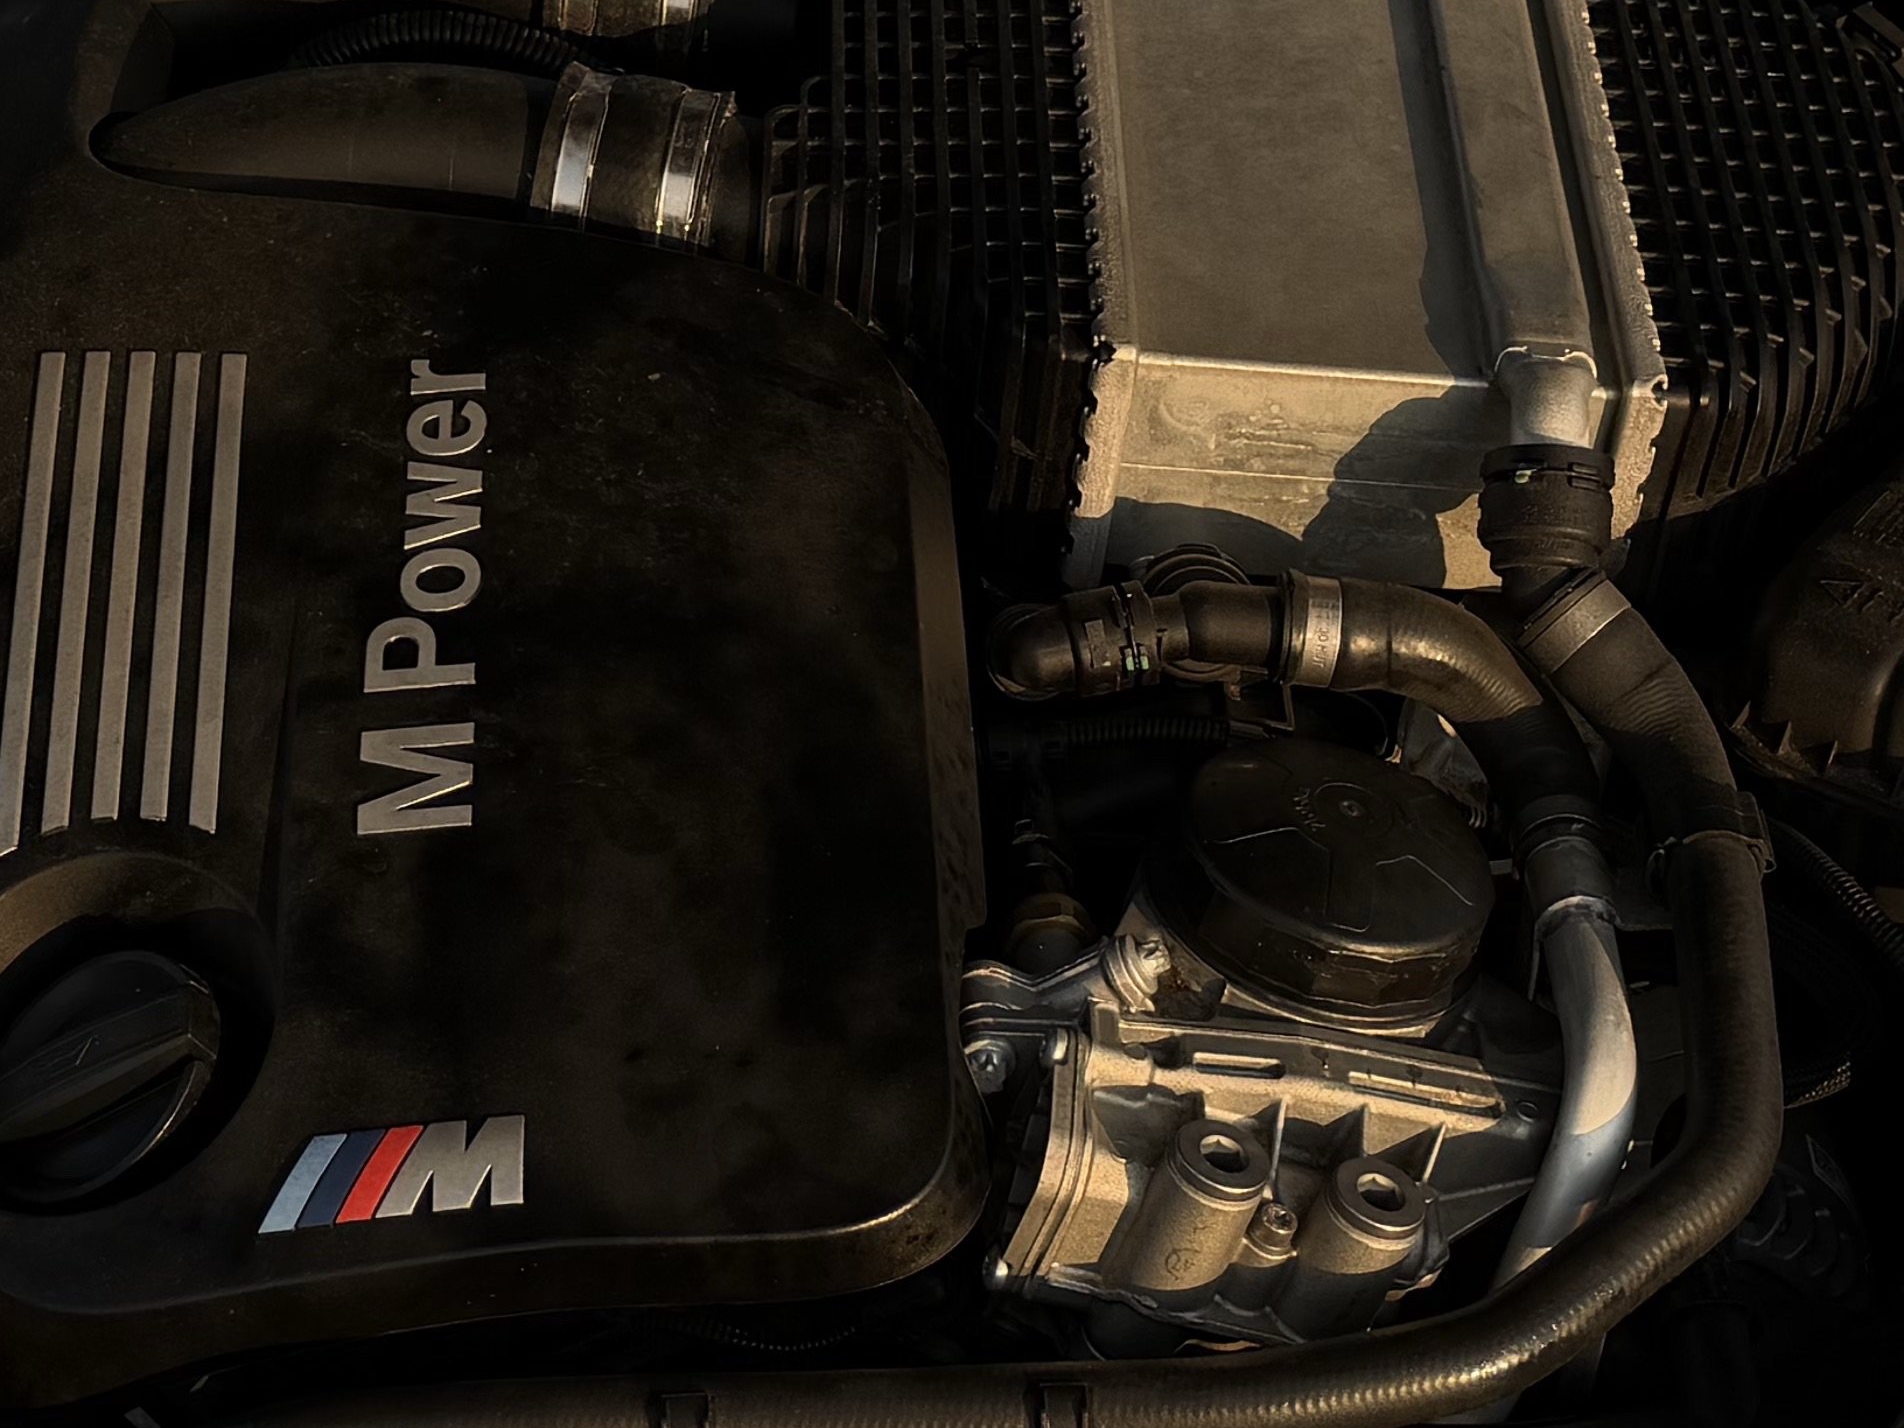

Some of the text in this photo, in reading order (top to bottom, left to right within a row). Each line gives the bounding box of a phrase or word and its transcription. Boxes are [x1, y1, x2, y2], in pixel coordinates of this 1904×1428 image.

[357, 358, 488, 835] M Power
[374, 1113, 525, 1218] M
